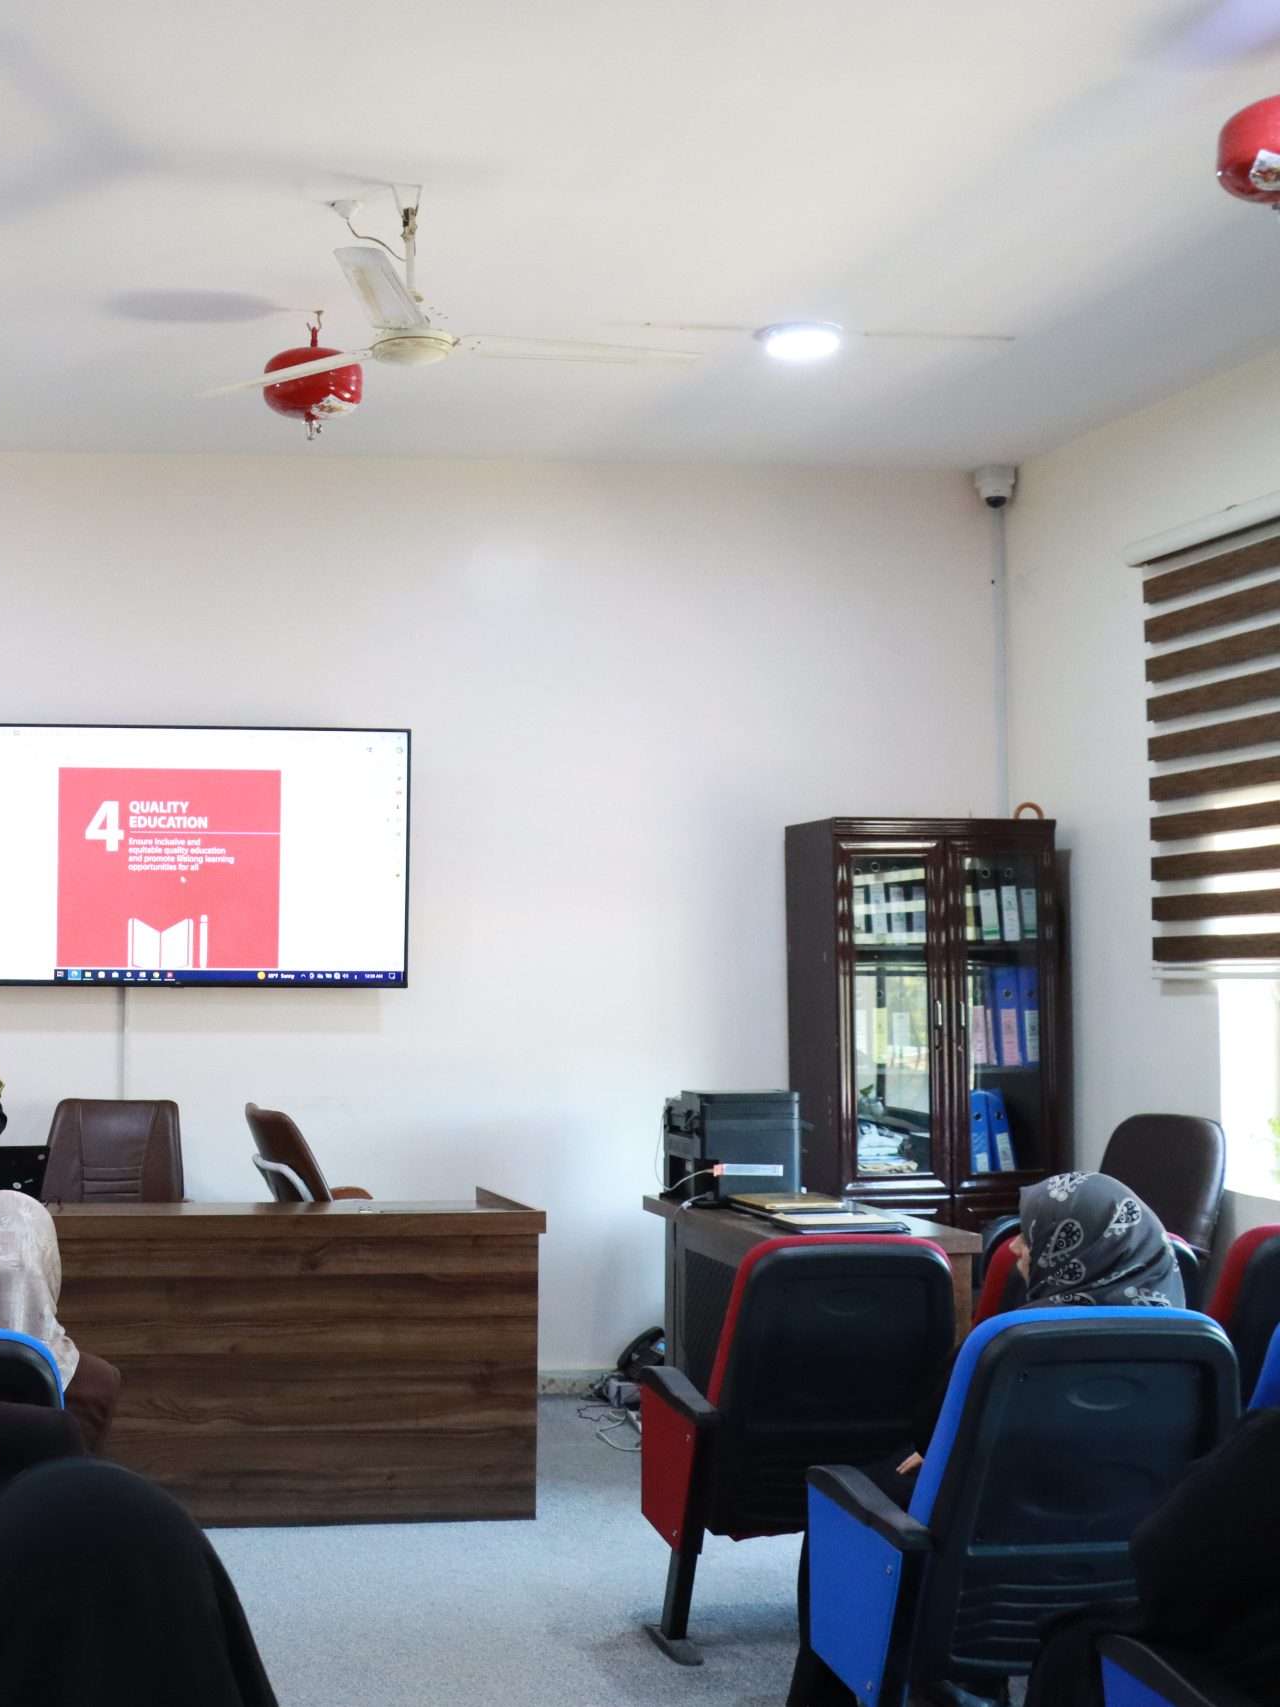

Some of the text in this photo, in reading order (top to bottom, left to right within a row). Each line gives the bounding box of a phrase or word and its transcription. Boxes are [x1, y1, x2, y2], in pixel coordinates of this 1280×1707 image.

[129, 800, 189, 814] QUALITY
[84, 800, 124, 852] 4
[129, 816, 208, 829] EDUCATION
[128, 838, 201, 846] Ensure inclusive and
[128, 846, 226, 855] equitable quality education
[128, 855, 142, 863] and
[144, 855, 175, 864] promote
[205, 855, 235, 864] learning
[128, 863, 200, 872] opportunities for all
